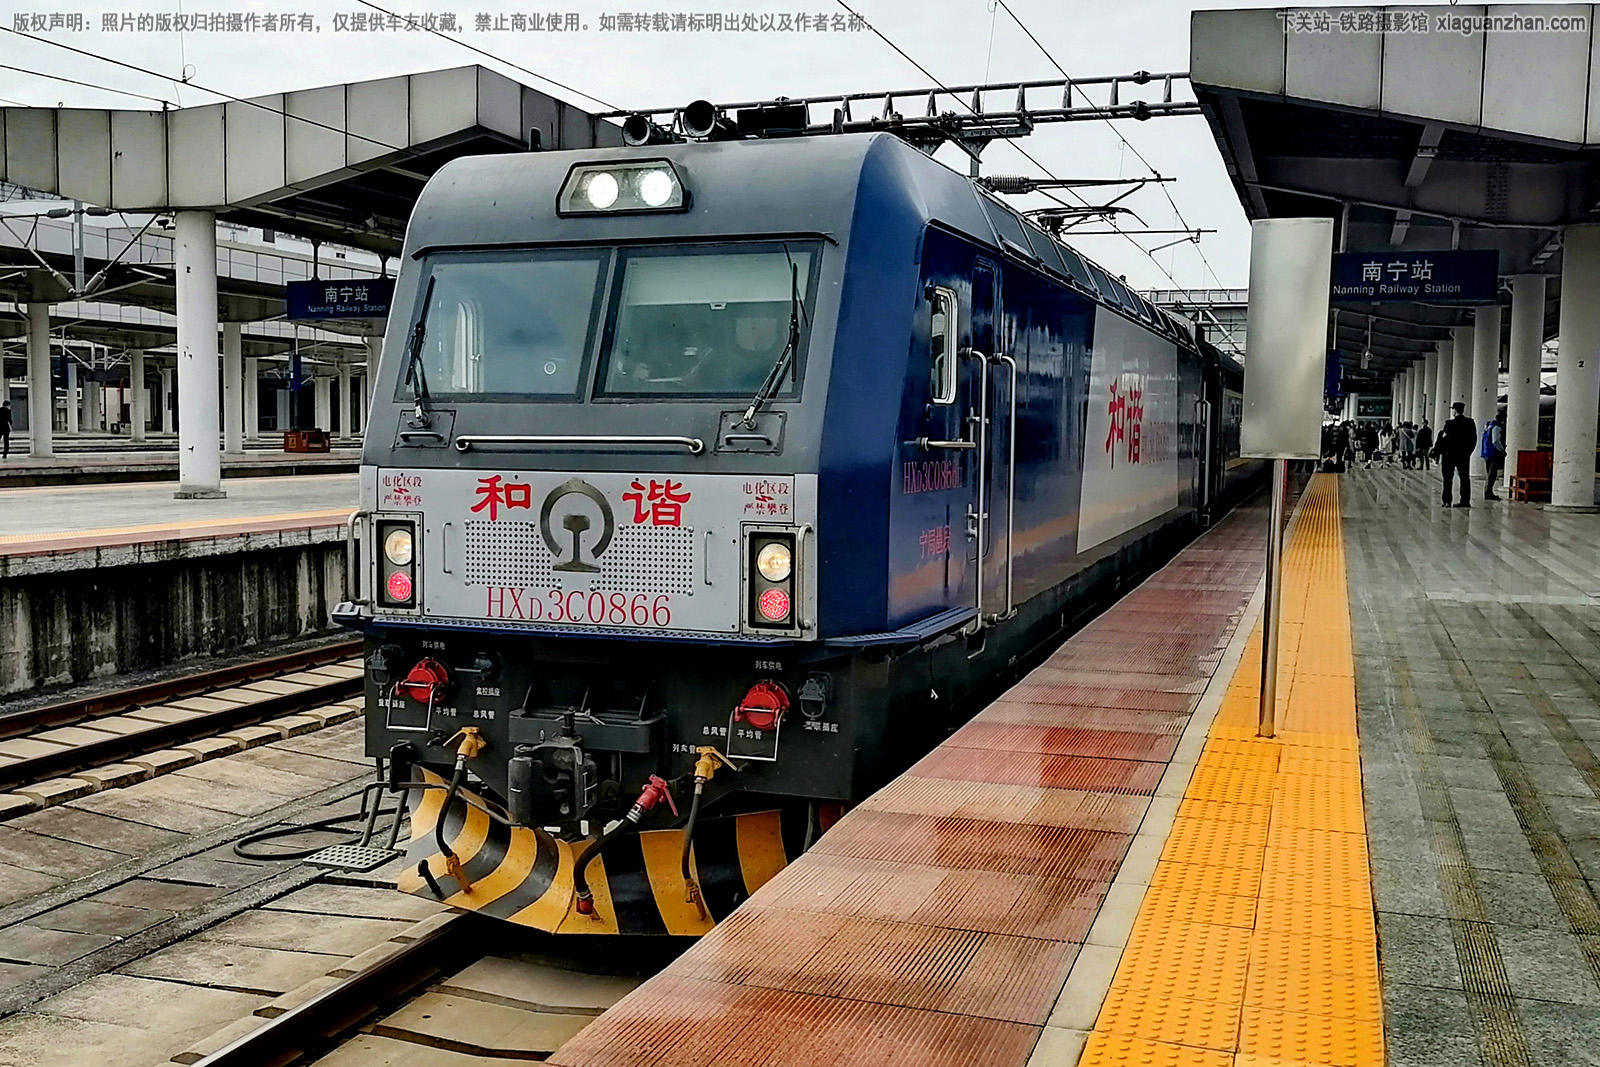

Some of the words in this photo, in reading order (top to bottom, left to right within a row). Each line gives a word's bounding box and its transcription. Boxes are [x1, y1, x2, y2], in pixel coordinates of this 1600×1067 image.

[1362, 260, 1434, 282] 南宁站
[325, 286, 369, 303] 南宁站
[1333, 285, 1374, 296] Nanning
[1380, 284, 1420, 295] Railway
[1424, 284, 1461, 293] Station
[308, 305, 334, 314] Nanning
[336, 304, 361, 313] Railway
[363, 304, 386, 312] Station
[1578, 360, 1585, 368] 2
[1106, 377, 1143, 469] 和谐
[471, 475, 532, 521] 和
[623, 480, 691, 527] 谐
[435, 707, 457, 717] 平均管
[473, 710, 495, 720] 总风管
[702, 726, 728, 737] 总风管
[737, 729, 762, 741] 平均管
